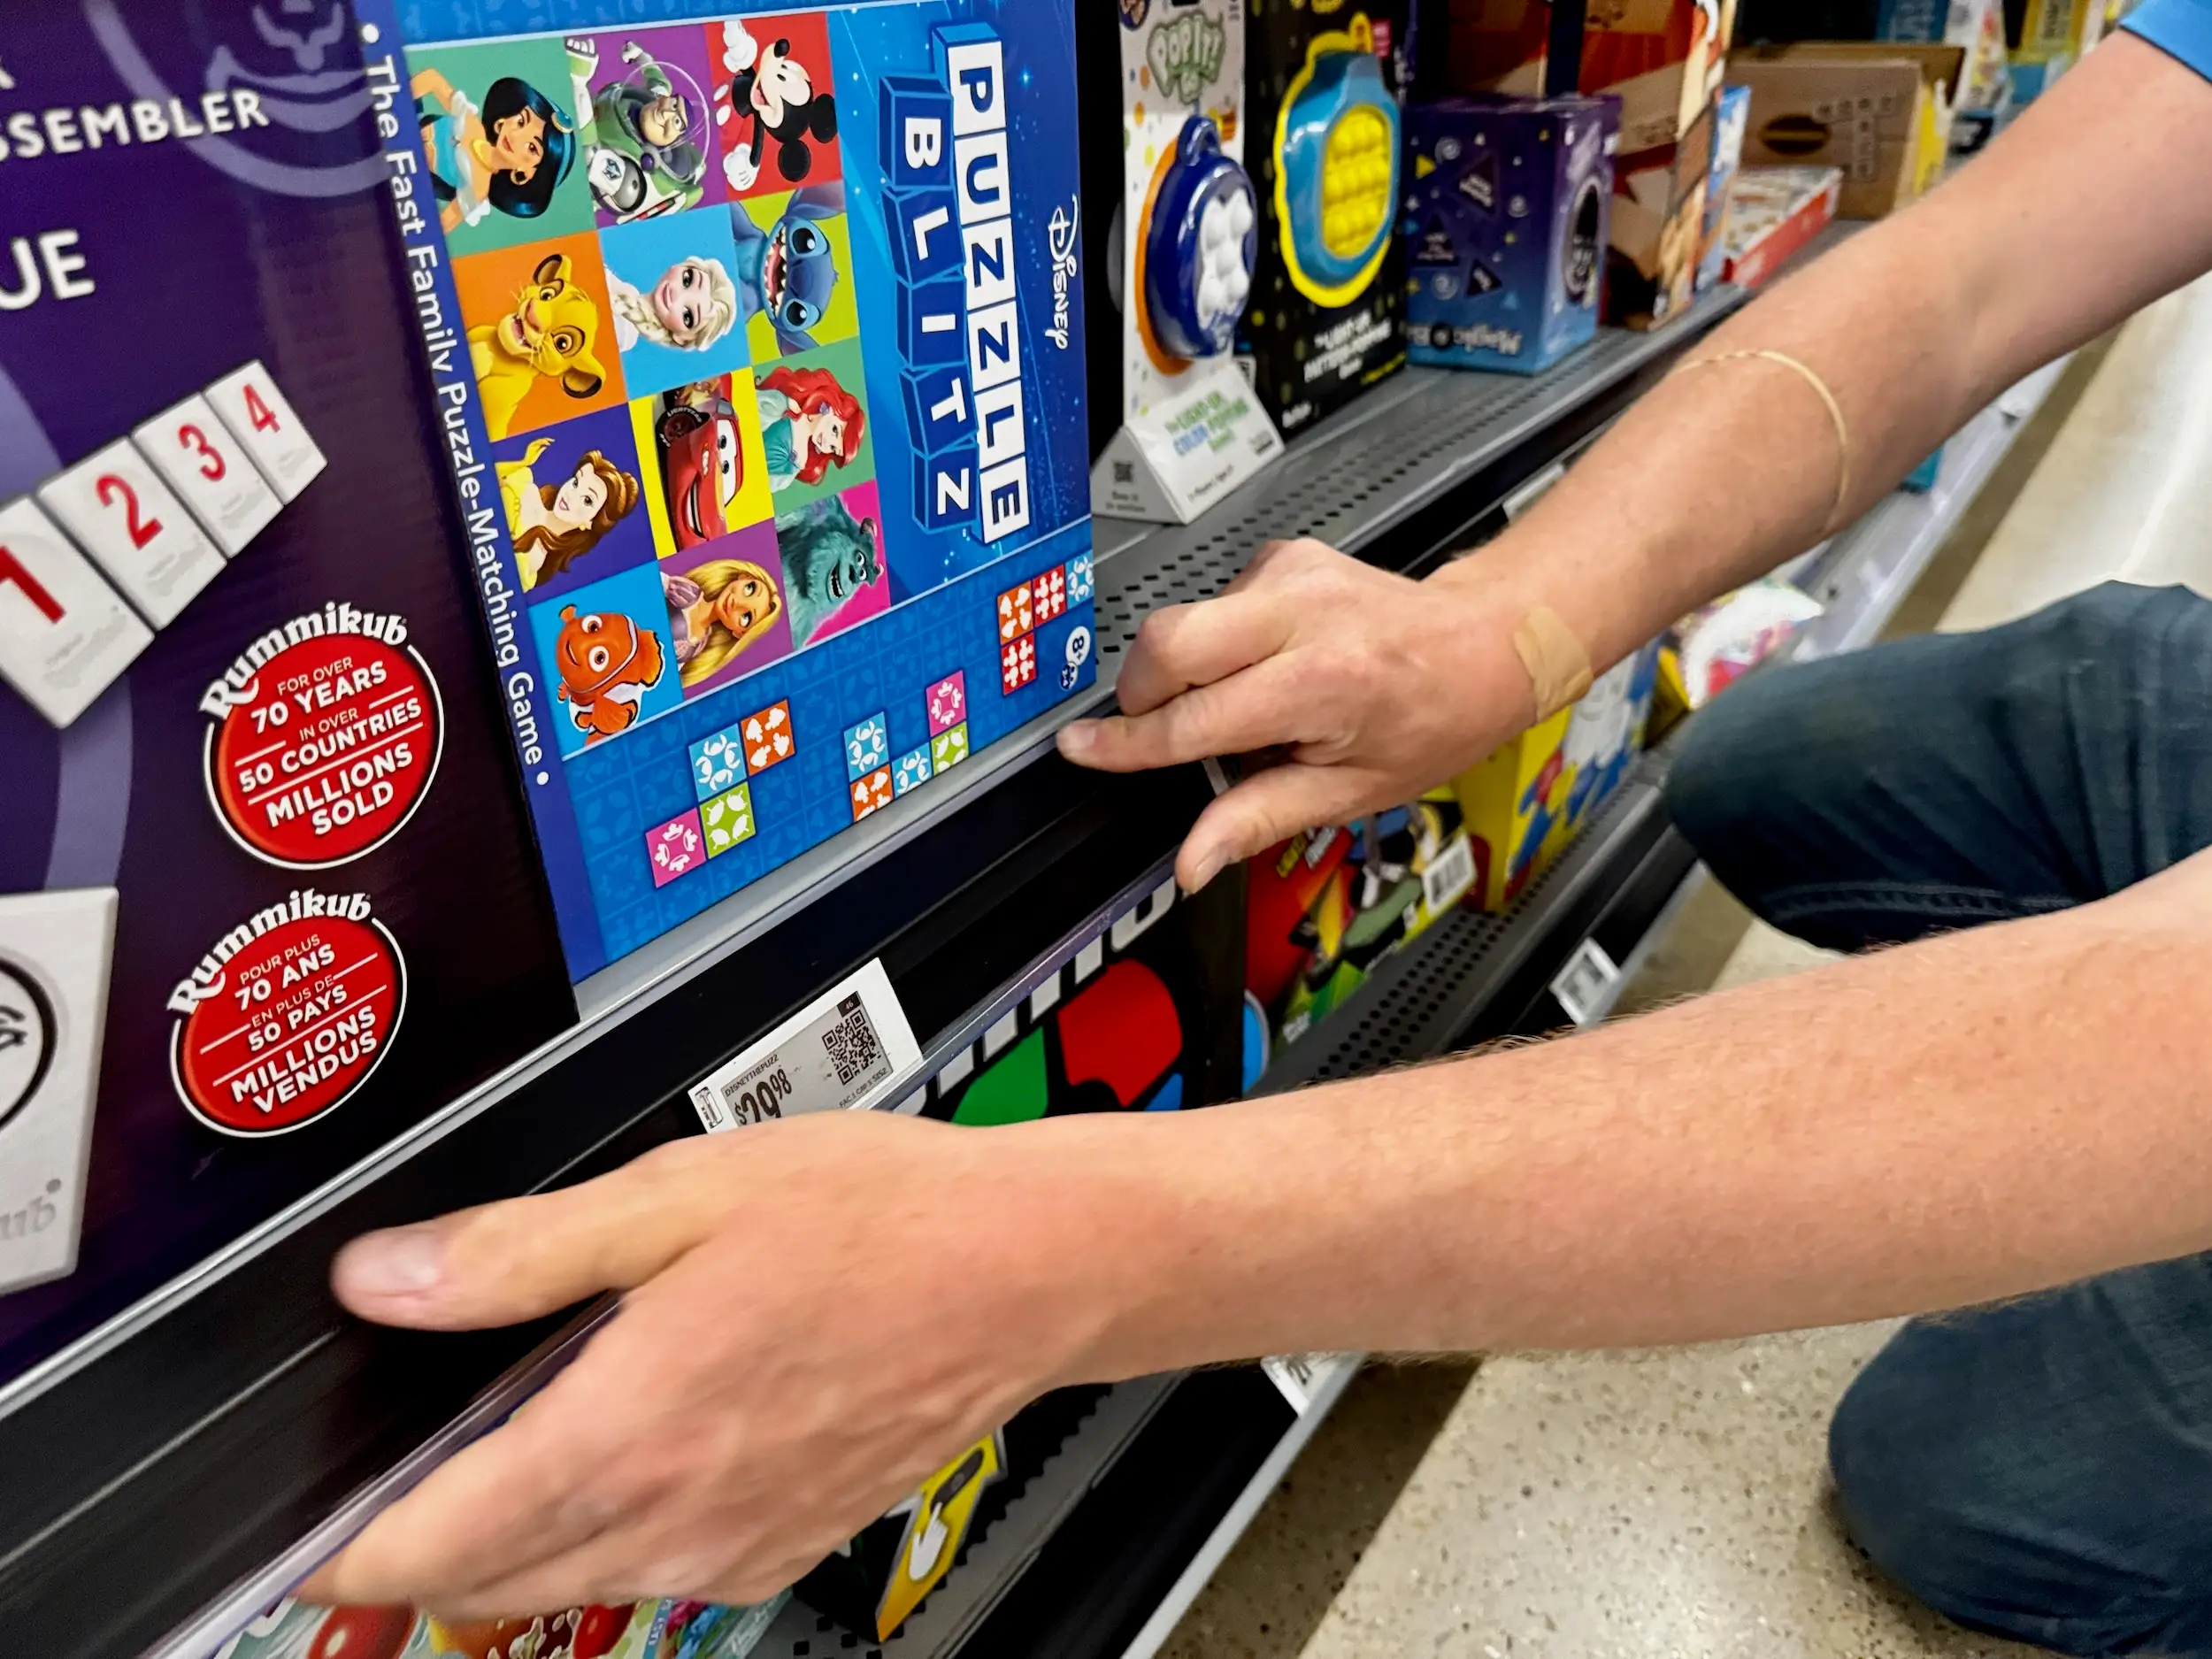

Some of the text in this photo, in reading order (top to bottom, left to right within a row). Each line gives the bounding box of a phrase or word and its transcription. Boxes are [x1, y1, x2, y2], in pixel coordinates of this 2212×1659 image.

[959, 65, 1021, 526] PUZZLE
[1045, 193, 1079, 350] Disney
[904, 117, 971, 516] BLITZ
[366, 55, 402, 139] The
[384, 150, 426, 238] Fast
[438, 381, 521, 667] Puzzle-Matching
[507, 672, 543, 765] Game
[0, 383, 280, 625] 1 2 3 4
[198, 602, 407, 720] Rummikub
[250, 661, 387, 733] 70 YEARS
[277, 657, 353, 695] FOR OVER
[239, 697, 422, 793] 50 COUNTRIES
[299, 708, 358, 741] IN OVER
[266, 742, 413, 827] MILLIONS
[311, 781, 394, 835] SOLD
[166, 887, 372, 1015] Rummikub
[234, 943, 335, 1010] 70 ANS
[239, 933, 320, 985] POUR PLUS
[248, 984, 348, 1052] 50 PAYS
[251, 974, 334, 1028] EN PLUS DE
[231, 1005, 376, 1102] MILLIONS
[252, 1030, 377, 1113] VENDUS
